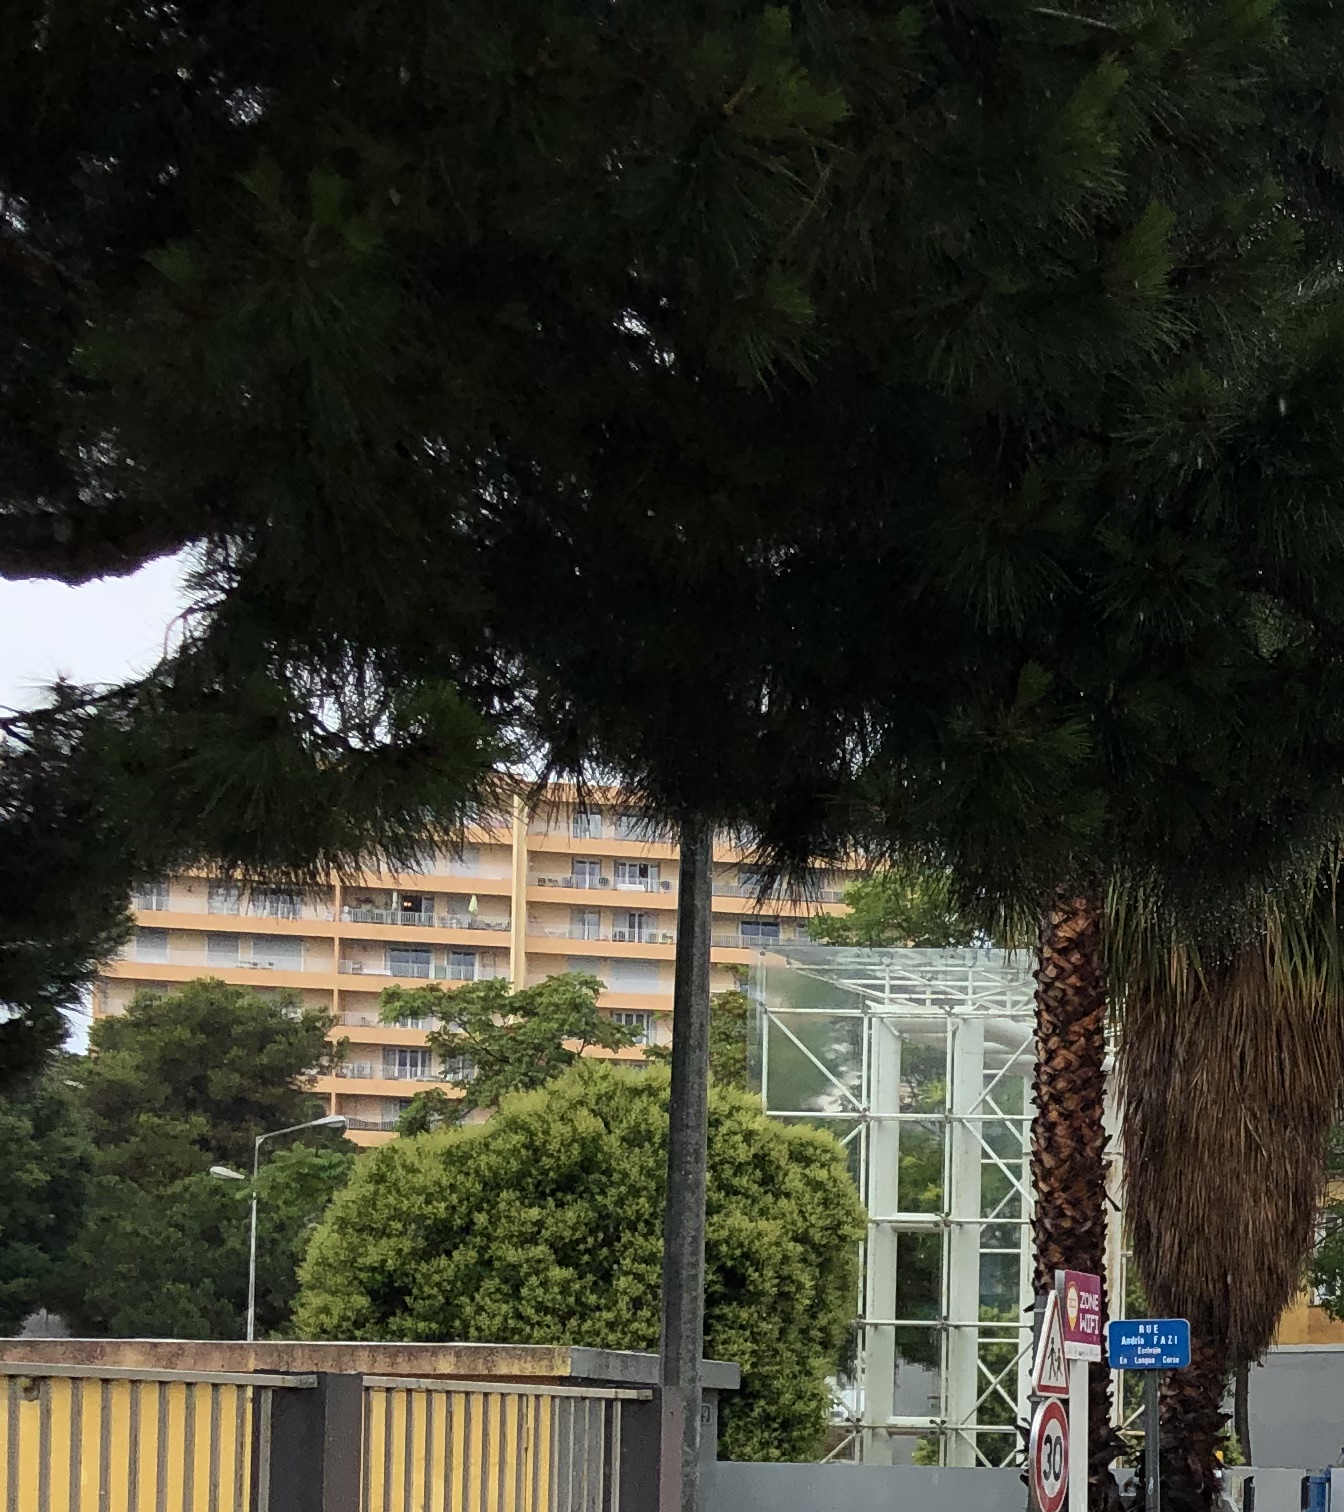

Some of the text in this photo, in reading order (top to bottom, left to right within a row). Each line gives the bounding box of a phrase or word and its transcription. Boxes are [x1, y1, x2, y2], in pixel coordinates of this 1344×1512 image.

[1079, 1291, 1099, 1311] ZONE
[1079, 1313, 1099, 1334] WIFI
[1138, 1324, 1159, 1334] RUE
[1120, 1356, 1127, 1364] En
[1043, 1434, 1062, 1482] 30
